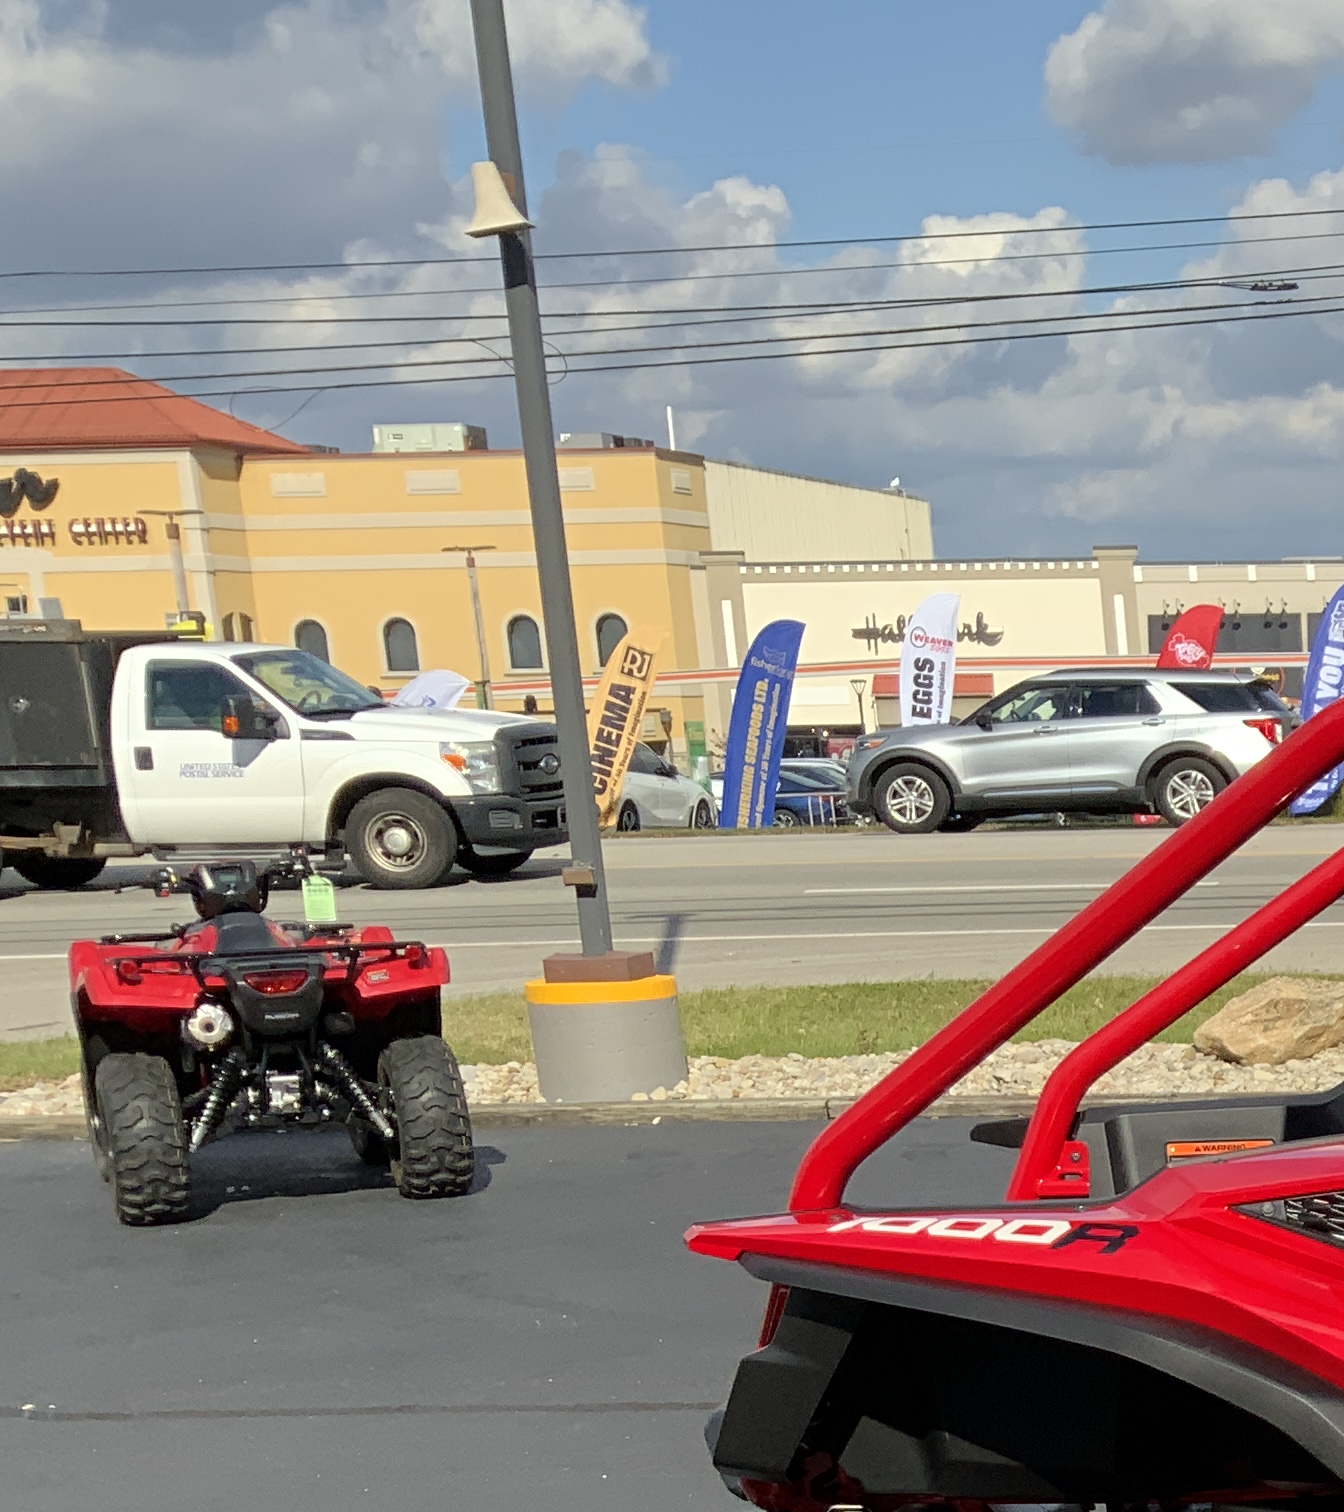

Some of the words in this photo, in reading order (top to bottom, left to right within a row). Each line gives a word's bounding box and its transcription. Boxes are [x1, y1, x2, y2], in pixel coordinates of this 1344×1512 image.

[0, 518, 56, 548] VENT
[68, 516, 149, 547] CENTER
[913, 632, 954, 648] WEAVER
[621, 647, 651, 680] RJ
[911, 656, 935, 719] EGGS
[592, 682, 637, 796] CINEMA
[745, 702, 765, 765] SEAFOODS
[179, 770, 210, 778] POSTAL
[212, 770, 244, 778] SERVICE
[1202, 1143, 1247, 1152] WARNING
